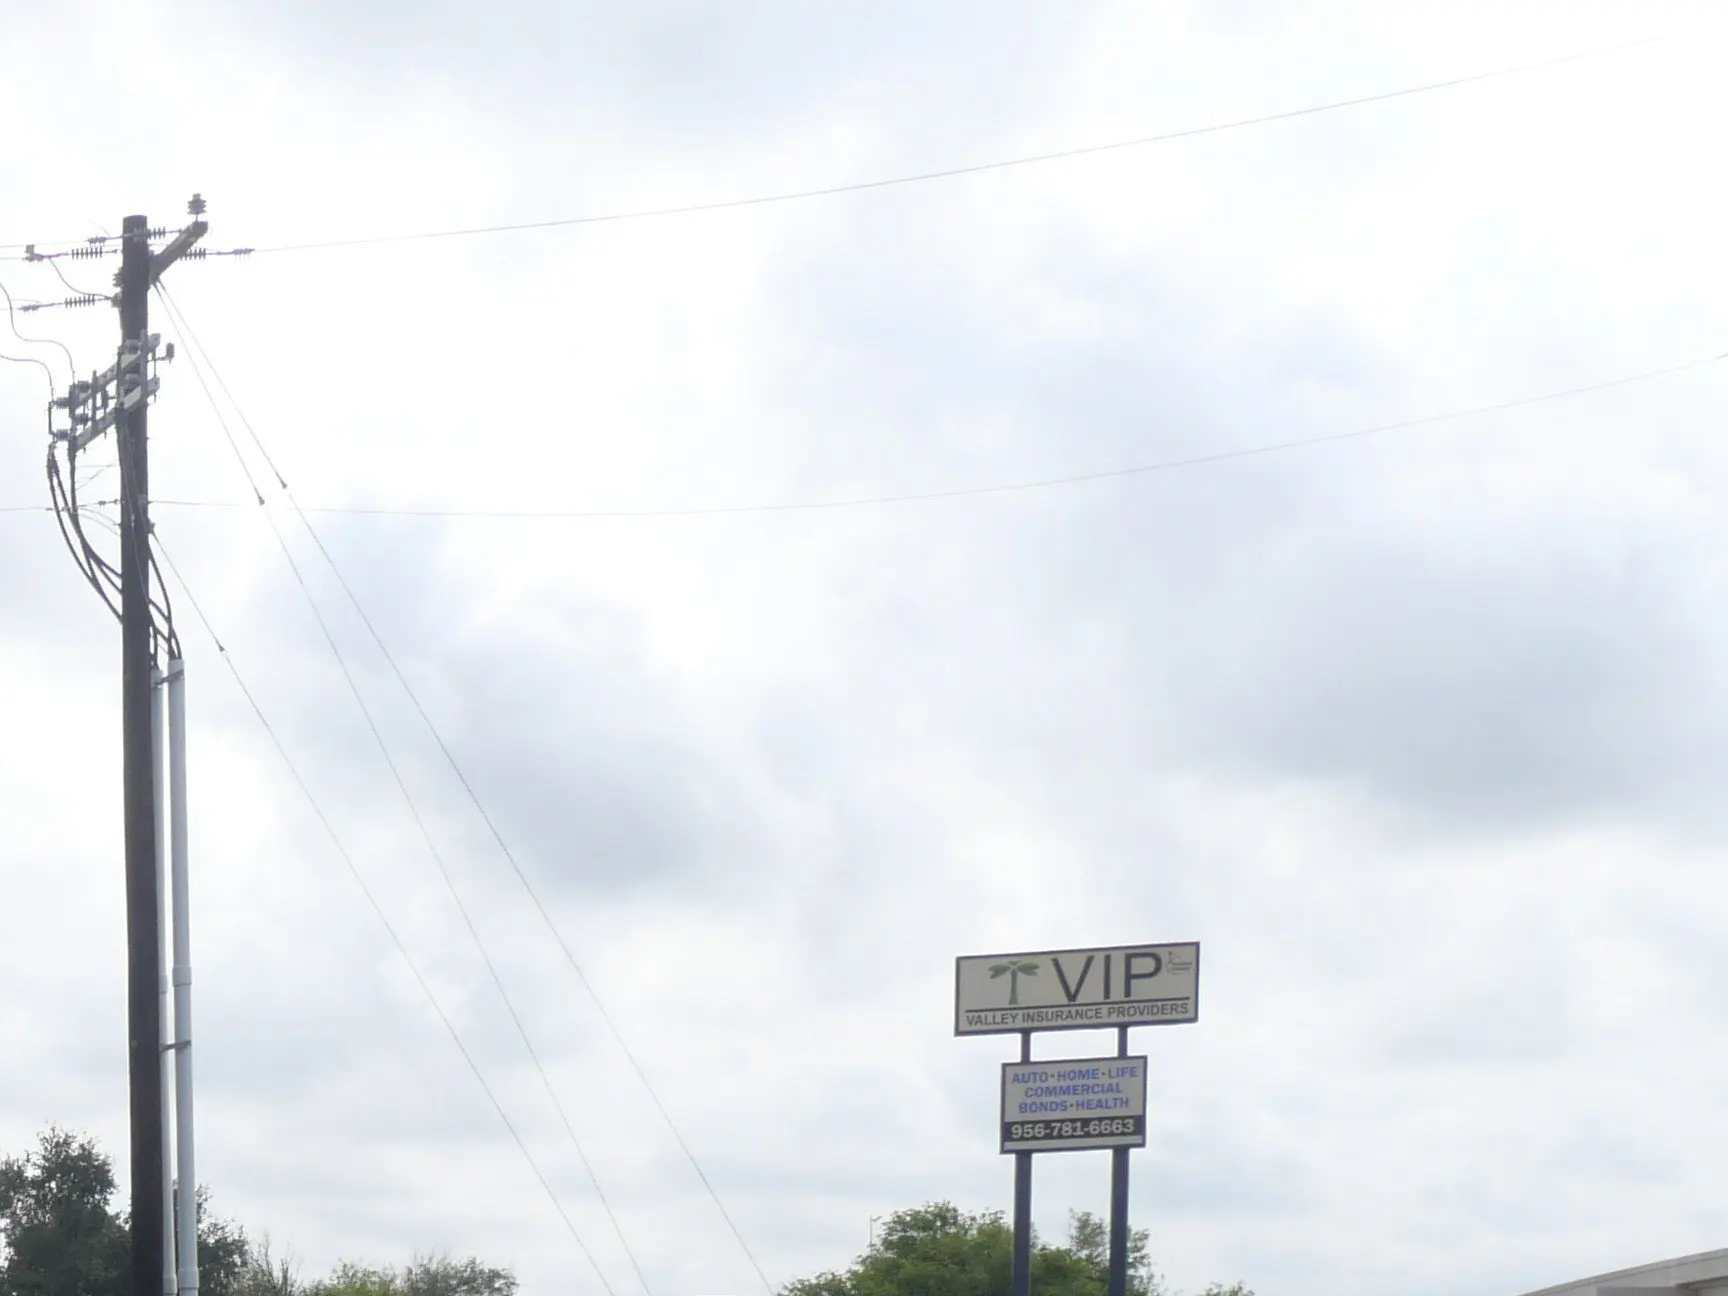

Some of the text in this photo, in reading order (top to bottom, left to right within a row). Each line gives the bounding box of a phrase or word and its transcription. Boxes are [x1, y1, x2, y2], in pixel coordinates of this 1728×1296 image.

[1051, 952, 1162, 1002] VIP
[966, 1002, 1189, 1027] VALLEY INSURANCE PROVIDERS
[1011, 1066, 1139, 1084] AUTO HOME LIFE
[1025, 1082, 1123, 1098] COMMERCIAL
[1018, 1097, 1129, 1113] BONDS HEALTH
[1011, 1119, 1135, 1139] 956-781-6663
